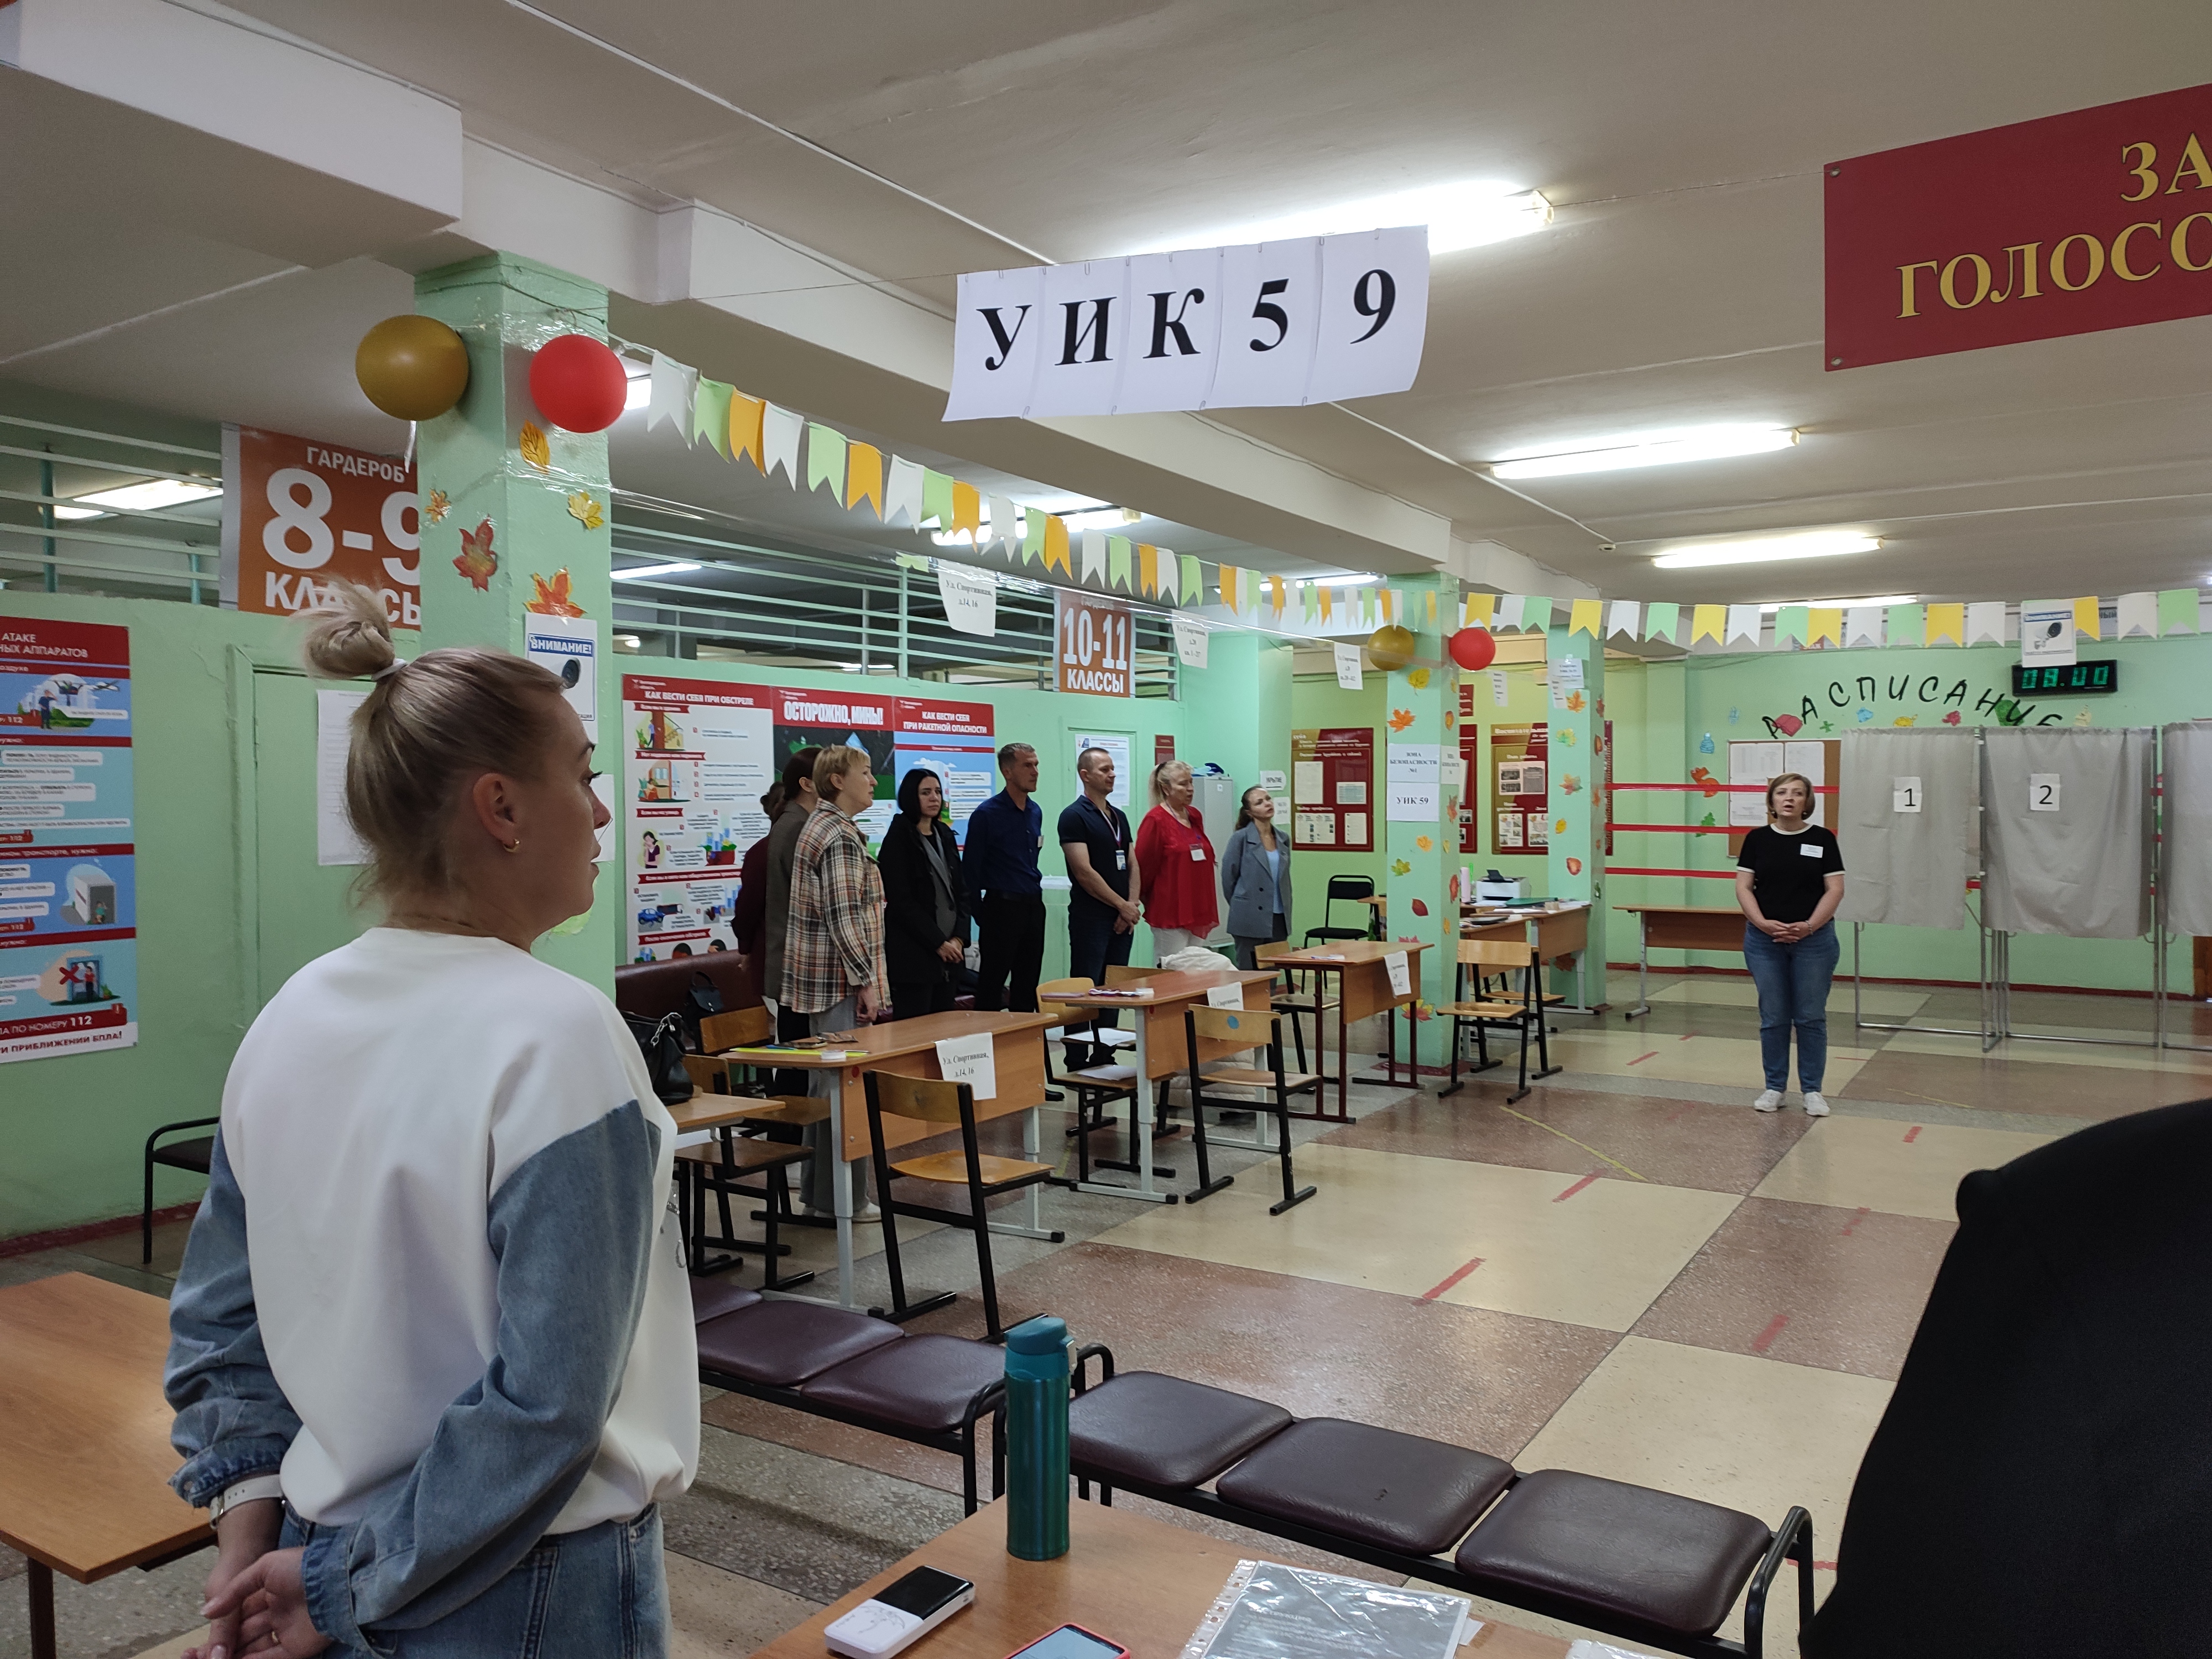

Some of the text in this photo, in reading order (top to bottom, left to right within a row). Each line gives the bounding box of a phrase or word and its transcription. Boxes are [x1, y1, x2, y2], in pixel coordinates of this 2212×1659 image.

[975, 288, 1205, 371] УИК
[307, 446, 405, 483] ГАРДЕРОБ
[262, 468, 420, 586] 8-9
[265, 571, 420, 625] КЛАС
[2, 633, 36, 643] АТАКЕ
[529, 636, 592, 655] ВНИМАНИЕ!
[1063, 607, 1128, 671] 10-11
[23, 645, 88, 658] АППАРАТОВ
[1067, 668, 1124, 693] КЛАССЫ
[645, 691, 754, 706] КАК ВЕСТИ СЕБЯ ПРИ ОБСТРЕЛЕ
[784, 701, 884, 726] ОСТОРОЖНО, МИНЫ!
[921, 711, 971, 722] КАК ВЕСТИ СЕБЯ
[903, 721, 988, 734] ПРИ РАКЕТНОЙ ОПАСНОСТИ
[1396, 796, 1429, 805] УИК 59
[1904, 788, 1917, 807] 1
[2038, 785, 2054, 805] 2
[12, 1025, 27, 1034] ПО
[29, 1020, 67, 1032] НОМЕРУ
[70, 1015, 92, 1027] 112
[11, 1036, 90, 1052] ПРИБЛИЖЕНИИ
[92, 1030, 122, 1042] БПЛА!
[953, 1052, 989, 1064] Спортивная,
